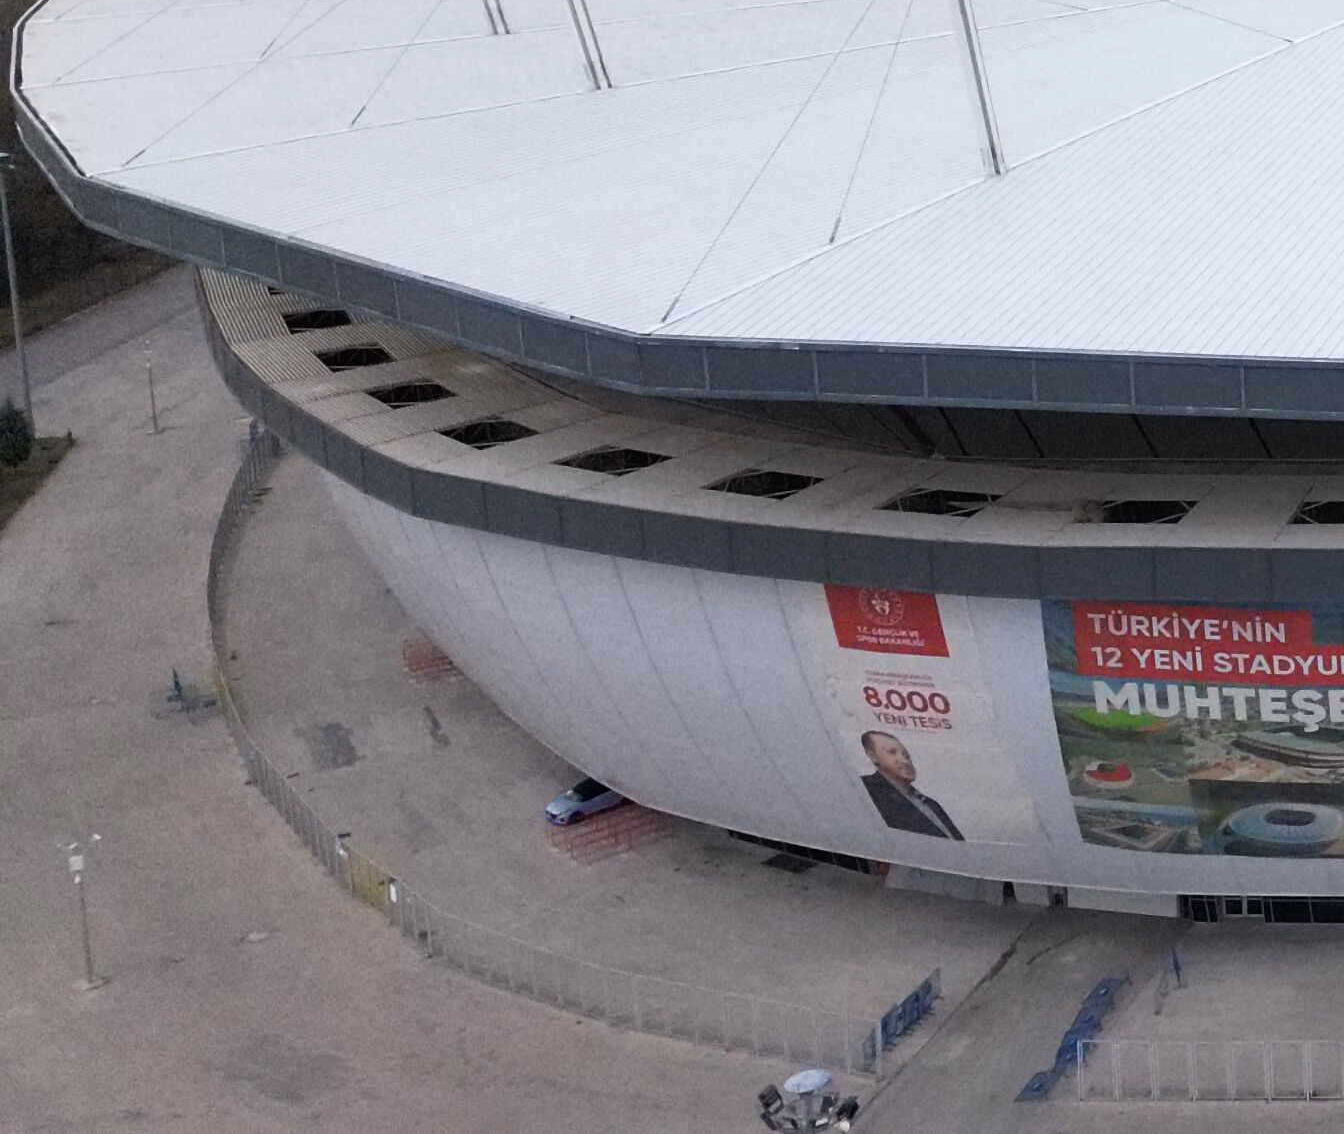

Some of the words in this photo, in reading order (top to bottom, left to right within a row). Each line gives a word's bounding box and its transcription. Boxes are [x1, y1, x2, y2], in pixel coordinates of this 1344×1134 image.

[1087, 610, 1286, 644] TÜRKİYE'NİN
[1091, 647, 1123, 668] 12
[1131, 646, 1203, 672] YENİ
[863, 686, 951, 715] 8.000
